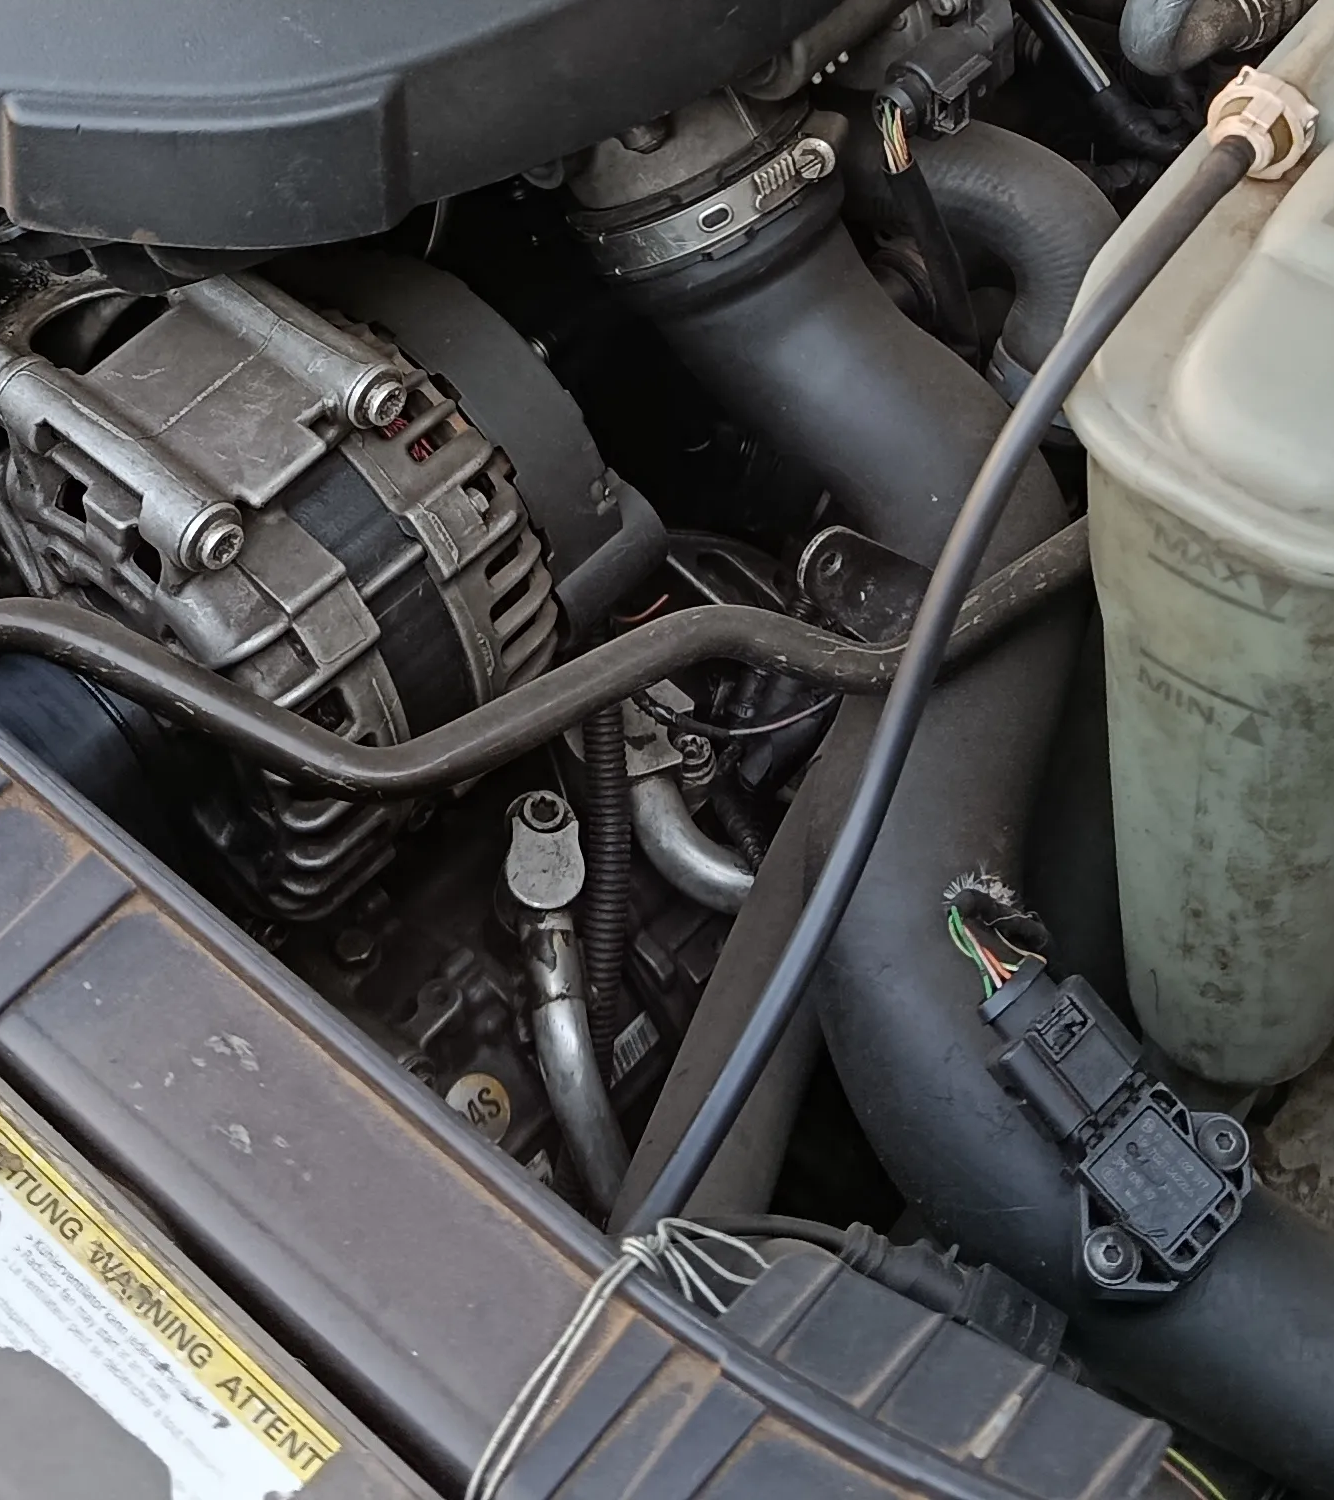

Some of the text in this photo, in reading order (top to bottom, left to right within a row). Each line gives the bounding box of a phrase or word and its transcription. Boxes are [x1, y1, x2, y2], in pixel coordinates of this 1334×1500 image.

[1153, 521, 1247, 591] MAX
[1137, 662, 1215, 726] MIN
[456, 1086, 501, 1127] 4S
